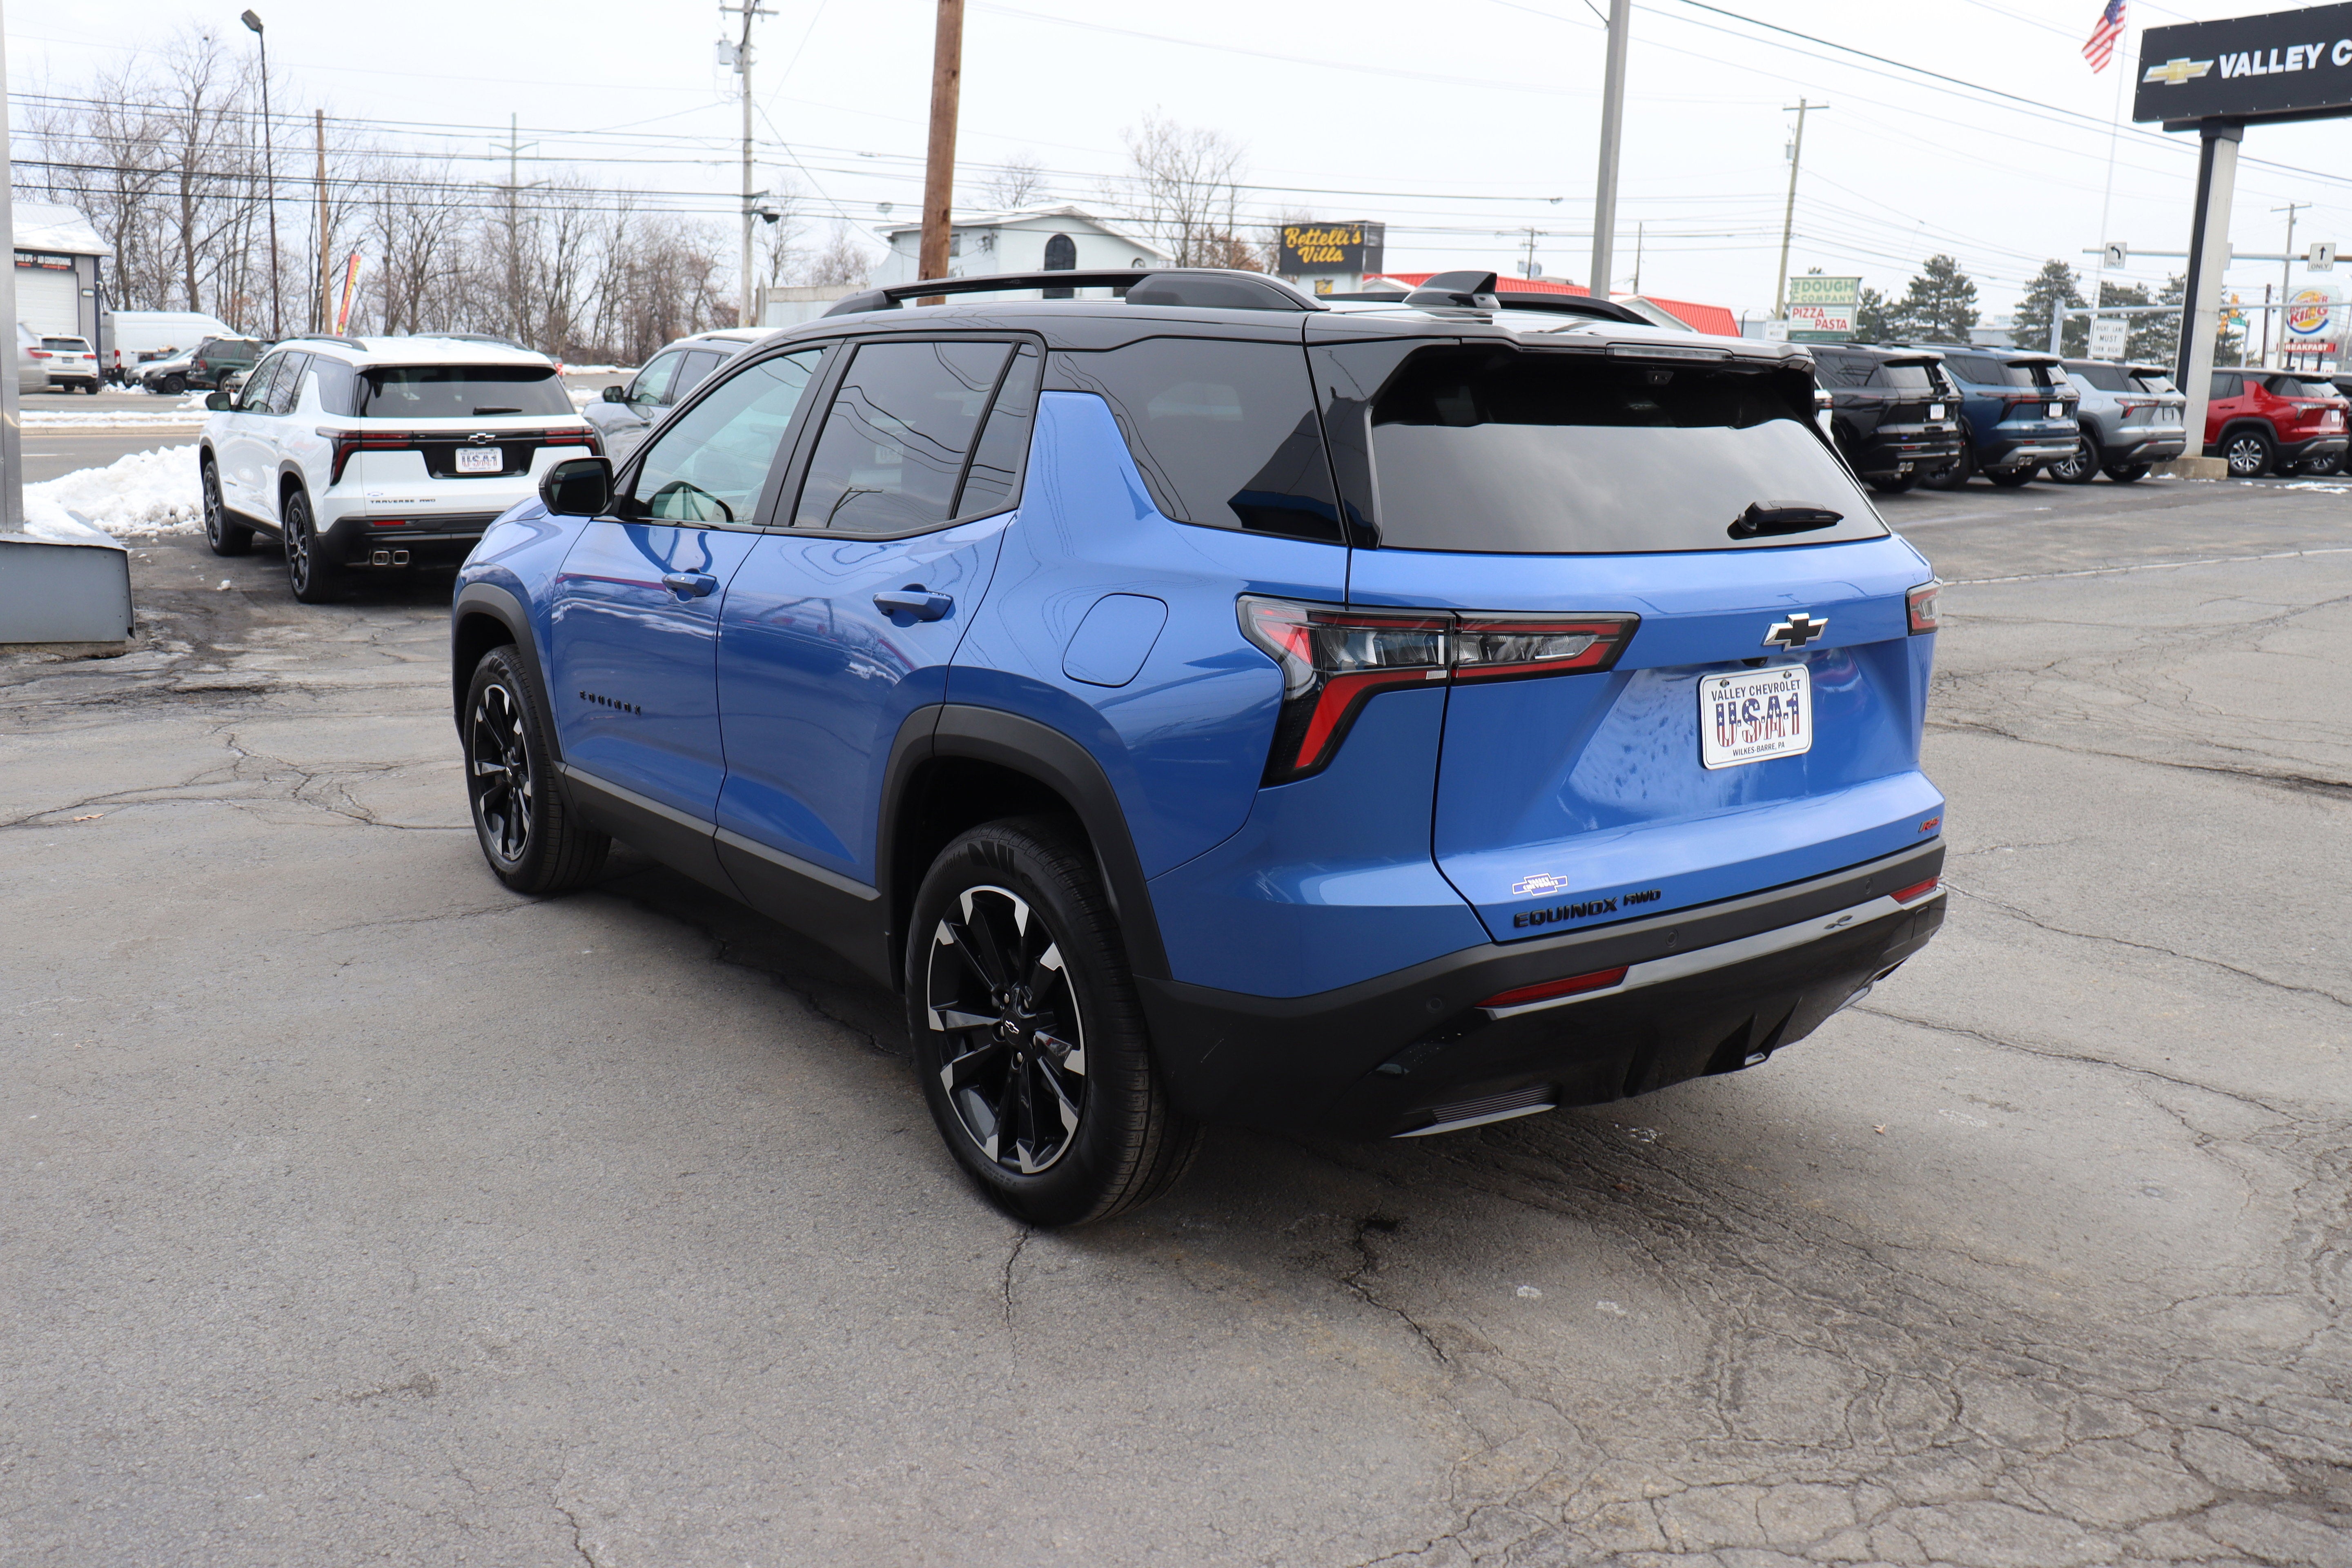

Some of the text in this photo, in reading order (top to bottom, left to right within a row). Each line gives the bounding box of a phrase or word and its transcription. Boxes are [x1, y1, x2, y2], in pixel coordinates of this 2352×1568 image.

[2219, 42, 2326, 79] VALLEY
[45, 256, 71, 266] CONDITIONING
[1297, 246, 1345, 263] Villa
[1802, 281, 1854, 293] DOUGH
[1793, 307, 1824, 318] PIZZA
[1815, 318, 1847, 330] PASTA
[2100, 334, 2117, 342] MUST
[1711, 679, 1800, 701] VALLEY CHEVROLET
[579, 690, 641, 716] EQUINOX
[1920, 815, 1941, 832] RS
[1527, 877, 1550, 885] VALLEY
[1514, 889, 1661, 927] EQUINOX AWD
